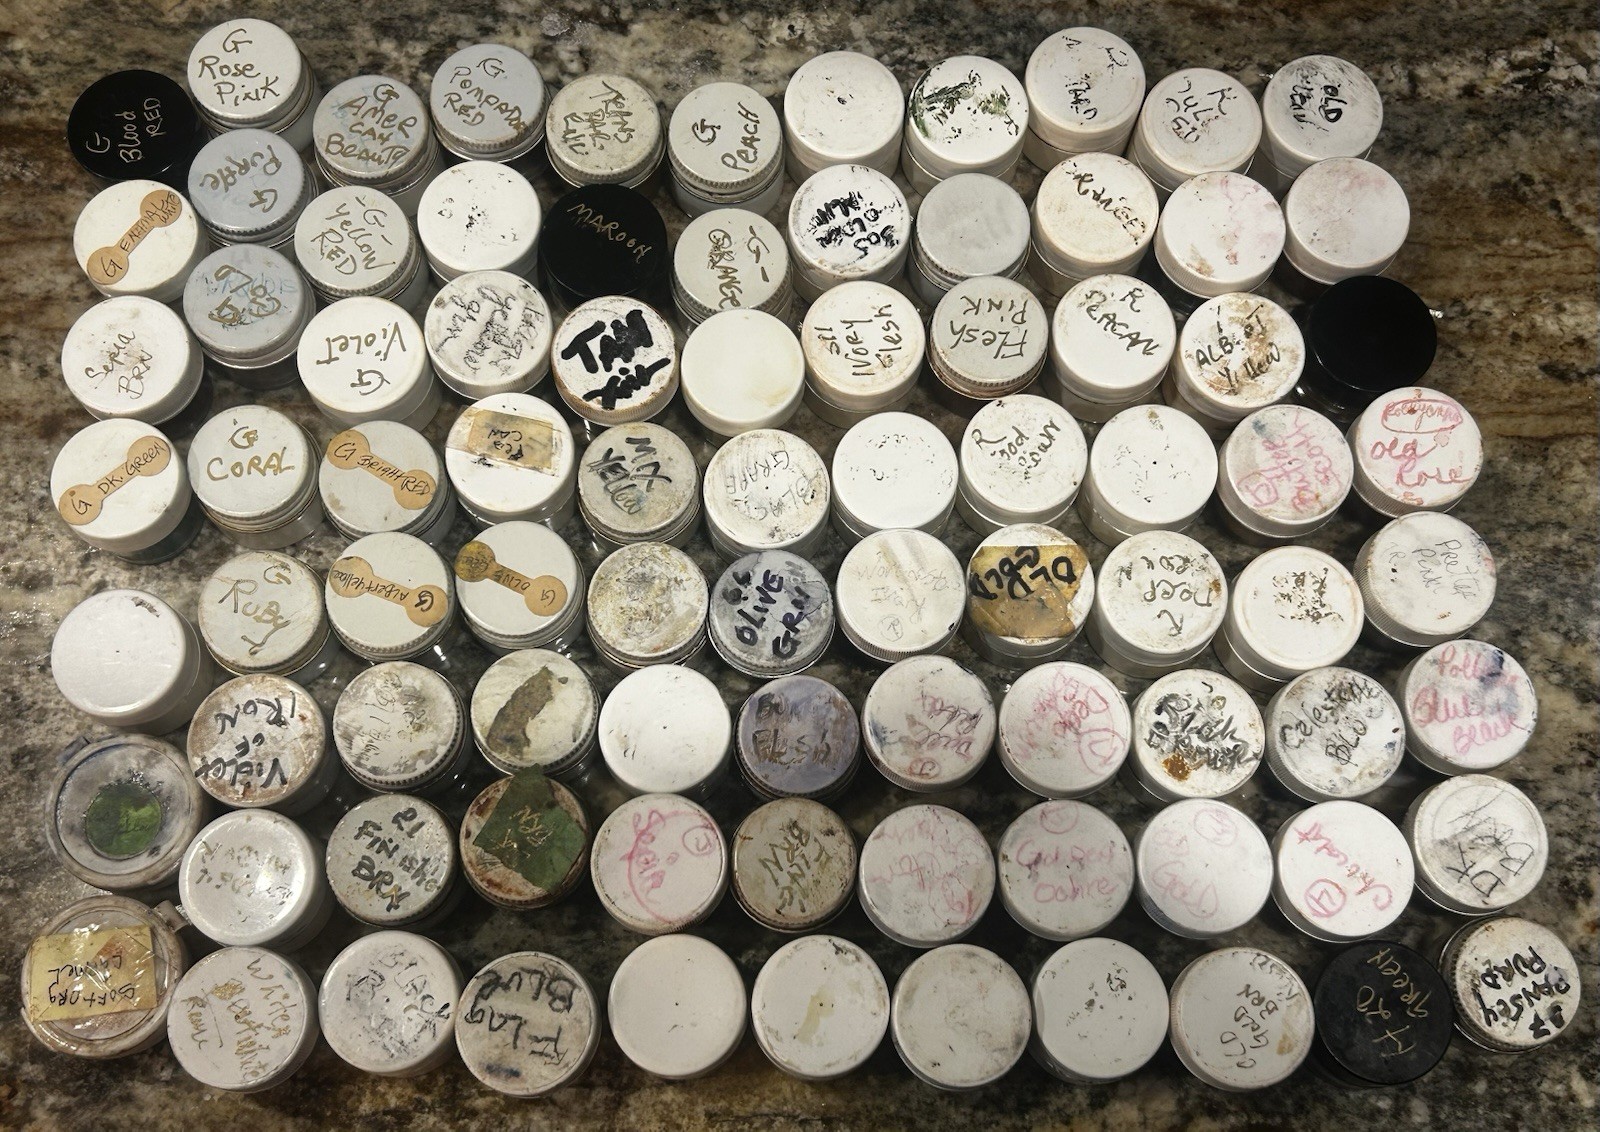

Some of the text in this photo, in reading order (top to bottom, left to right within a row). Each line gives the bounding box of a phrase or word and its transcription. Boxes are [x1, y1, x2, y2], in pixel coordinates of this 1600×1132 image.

[223, 29, 252, 53] G
[198, 56, 260, 79] Rose
[476, 58, 507, 79] G
[373, 84, 400, 106] G
[144, 97, 167, 138] RED
[444, 92, 486, 127] RED
[86, 132, 111, 154] G
[691, 118, 721, 146] G
[249, 187, 279, 213] G
[311, 227, 358, 276] RED
[101, 256, 124, 279] G
[1119, 286, 1145, 313] R
[117, 348, 154, 400] BRN
[349, 368, 391, 396] G
[229, 424, 261, 450] G
[970, 428, 1008, 451] R
[205, 446, 296, 482] CORAL
[332, 442, 356, 462] G
[70, 496, 93, 516] G
[539, 588, 557, 608] G
[1156, 608, 1185, 637] R
[1235, 984, 1280, 1021] BRN
[1219, 1030, 1257, 1069] OLD
